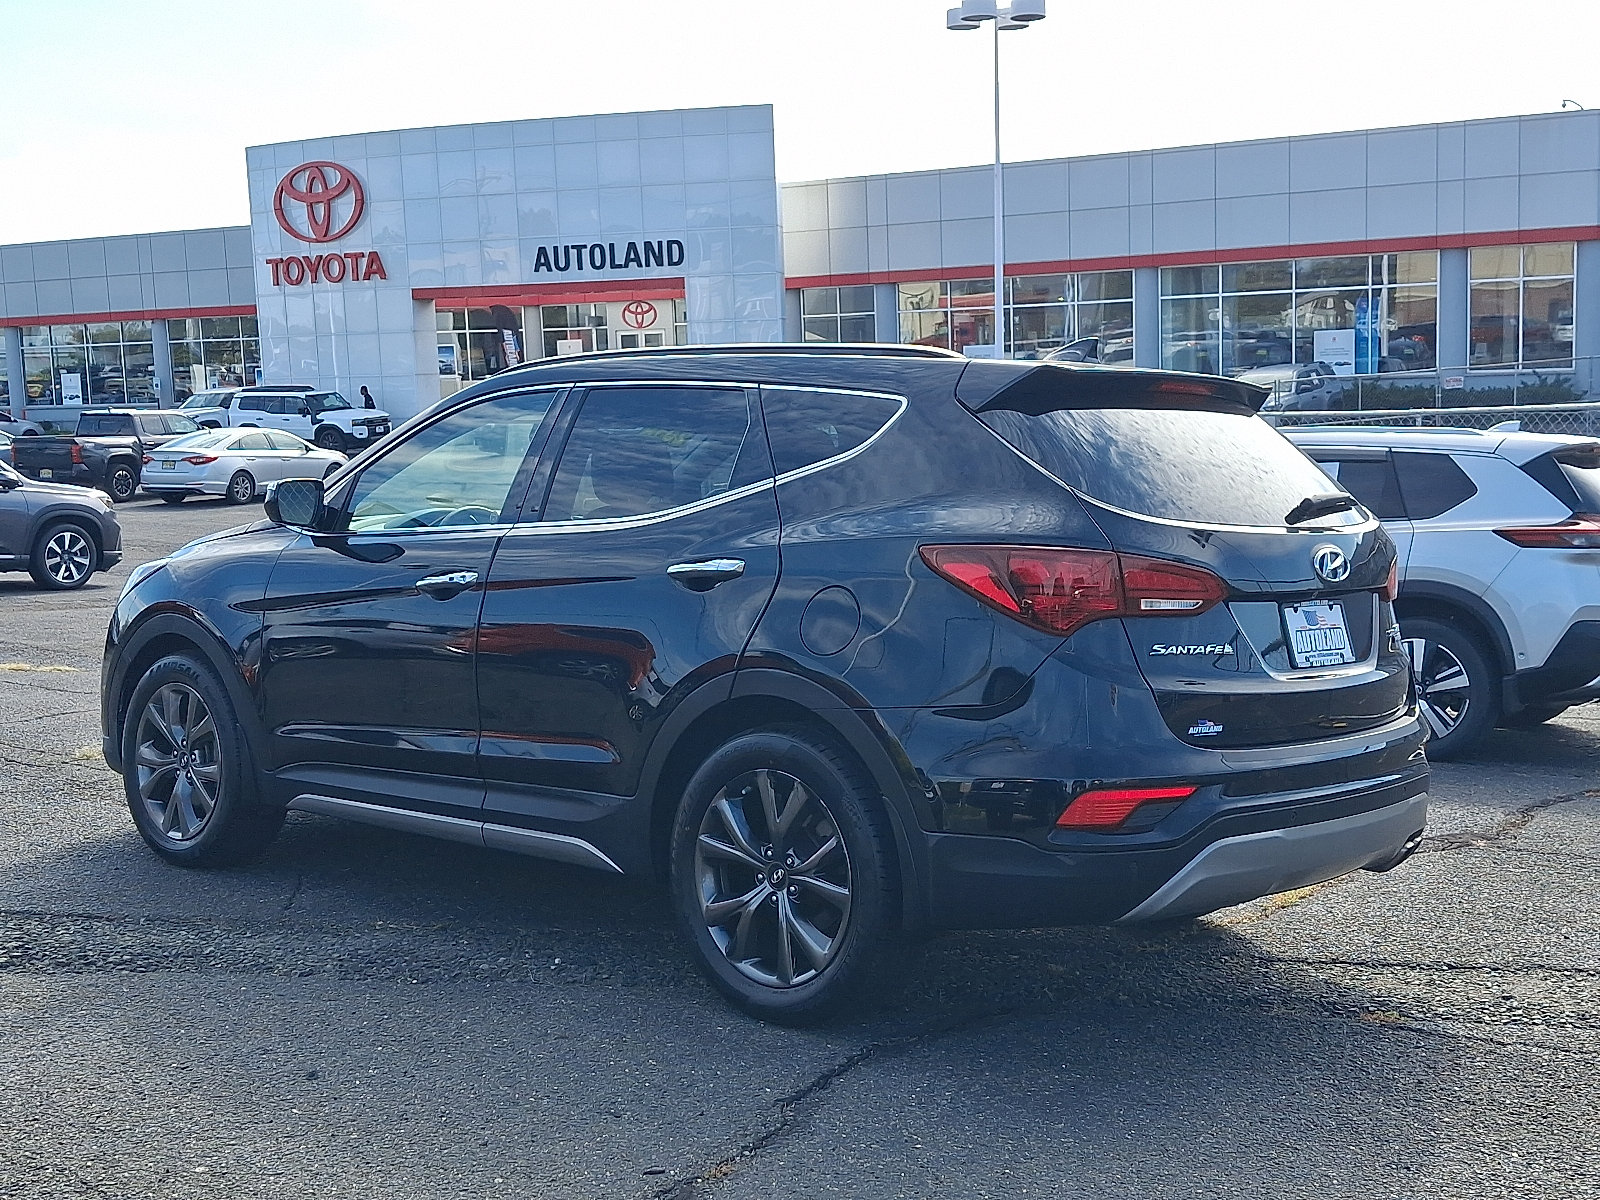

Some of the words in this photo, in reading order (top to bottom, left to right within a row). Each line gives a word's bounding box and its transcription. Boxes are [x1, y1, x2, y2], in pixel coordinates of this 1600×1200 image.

[266, 251, 387, 286] TOYOTA
[534, 239, 684, 273] AUTOLAND
[1296, 628, 1345, 653] AUTOLAND
[1188, 725, 1223, 734] AUTOLAND
